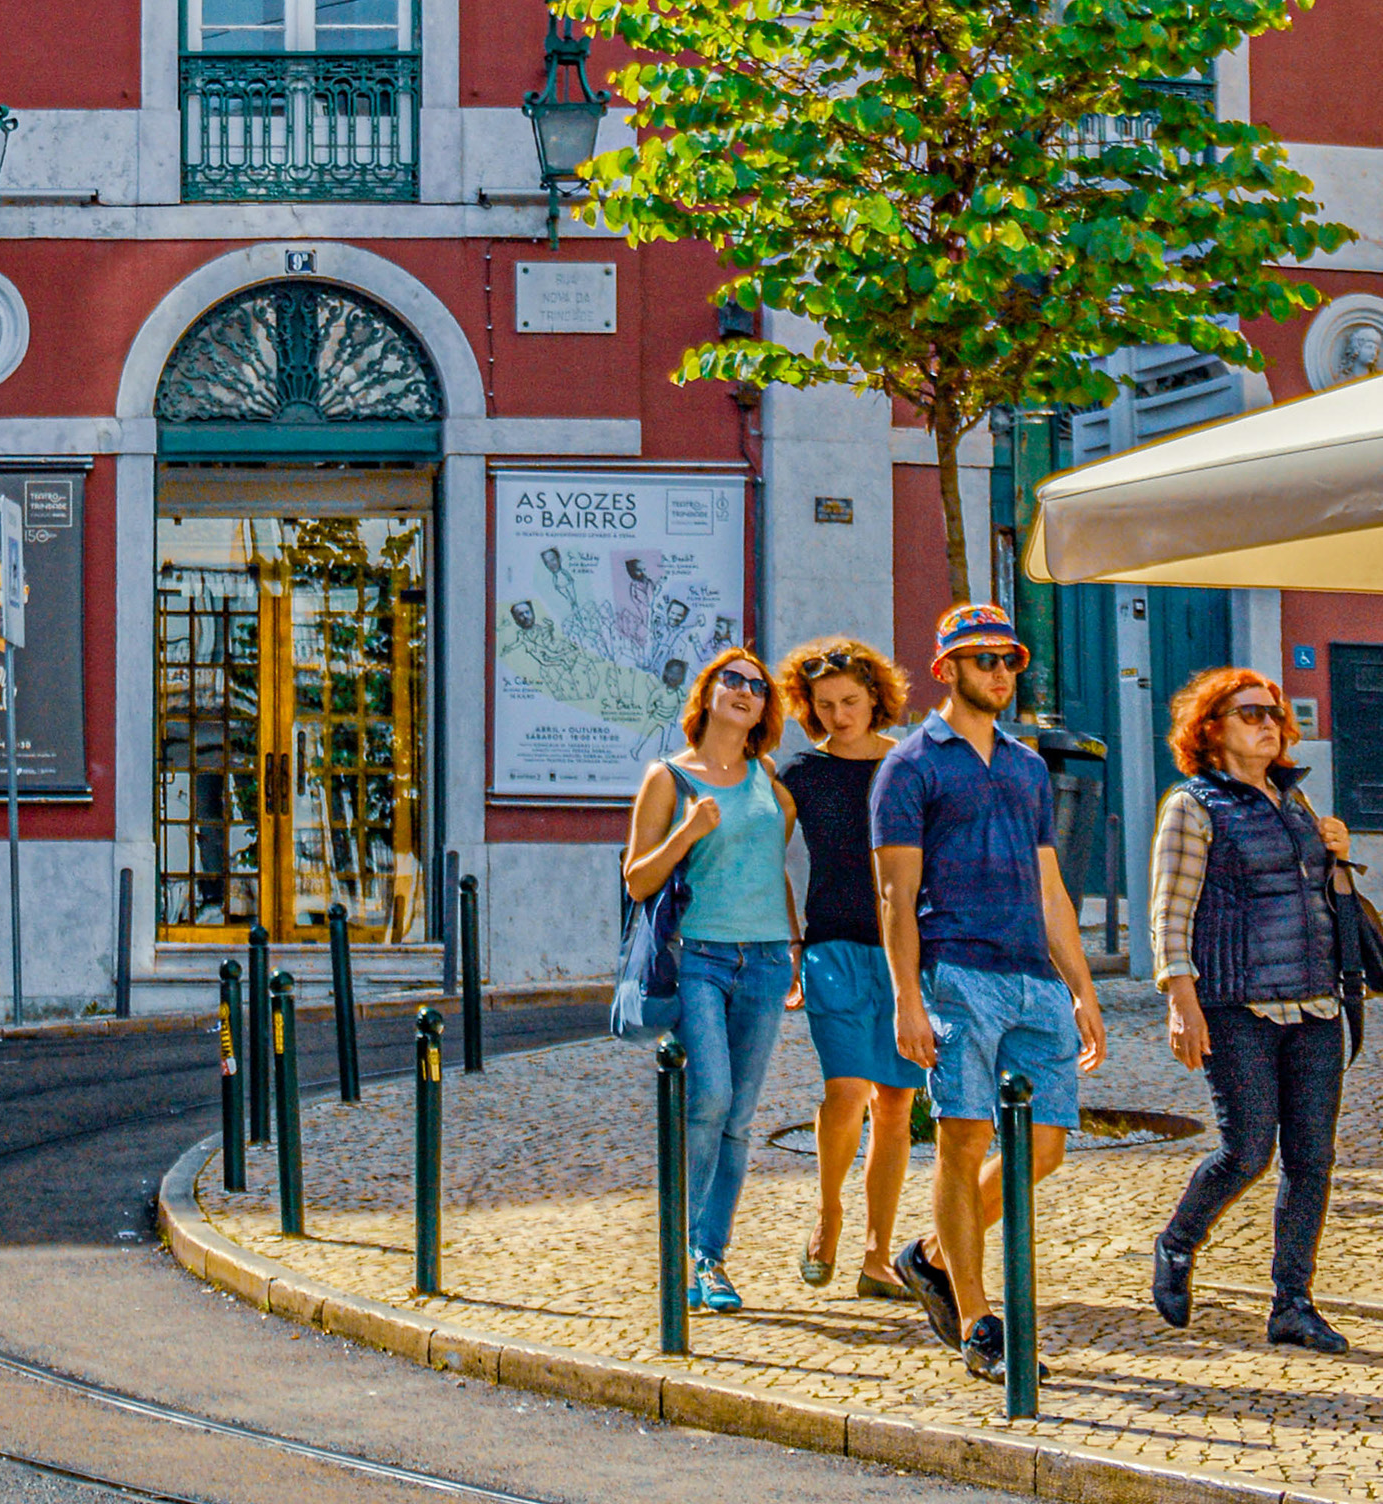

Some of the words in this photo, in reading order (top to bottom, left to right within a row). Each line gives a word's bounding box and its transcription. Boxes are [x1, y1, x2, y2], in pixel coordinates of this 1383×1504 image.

[516, 492, 546, 509] AS
[556, 492, 636, 511] VOZES
[515, 515, 533, 524] DO
[542, 511, 637, 529] BAIRRO
